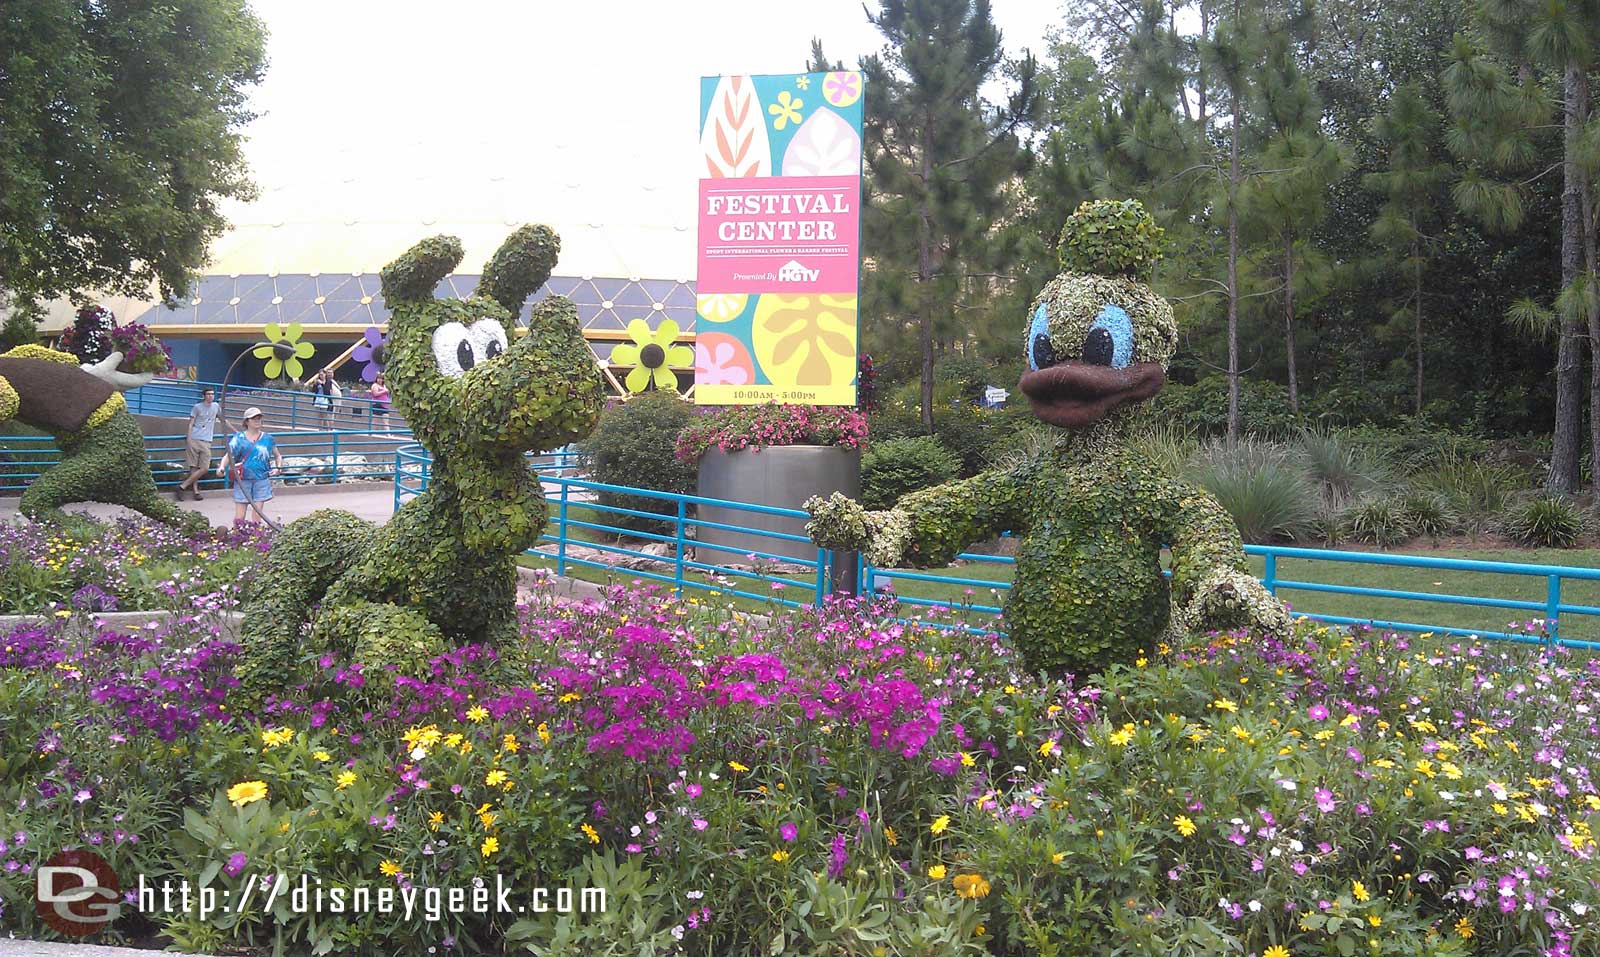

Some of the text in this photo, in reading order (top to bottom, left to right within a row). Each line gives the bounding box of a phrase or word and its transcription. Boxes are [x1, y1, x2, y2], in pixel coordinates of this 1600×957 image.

[706, 194, 849, 215] FESTIVAL
[718, 221, 836, 241] CENTER
[733, 268, 819, 282] Presented By HGTV
[734, 391, 773, 399] 10:00AM
[782, 391, 816, 399] 5:00PM
